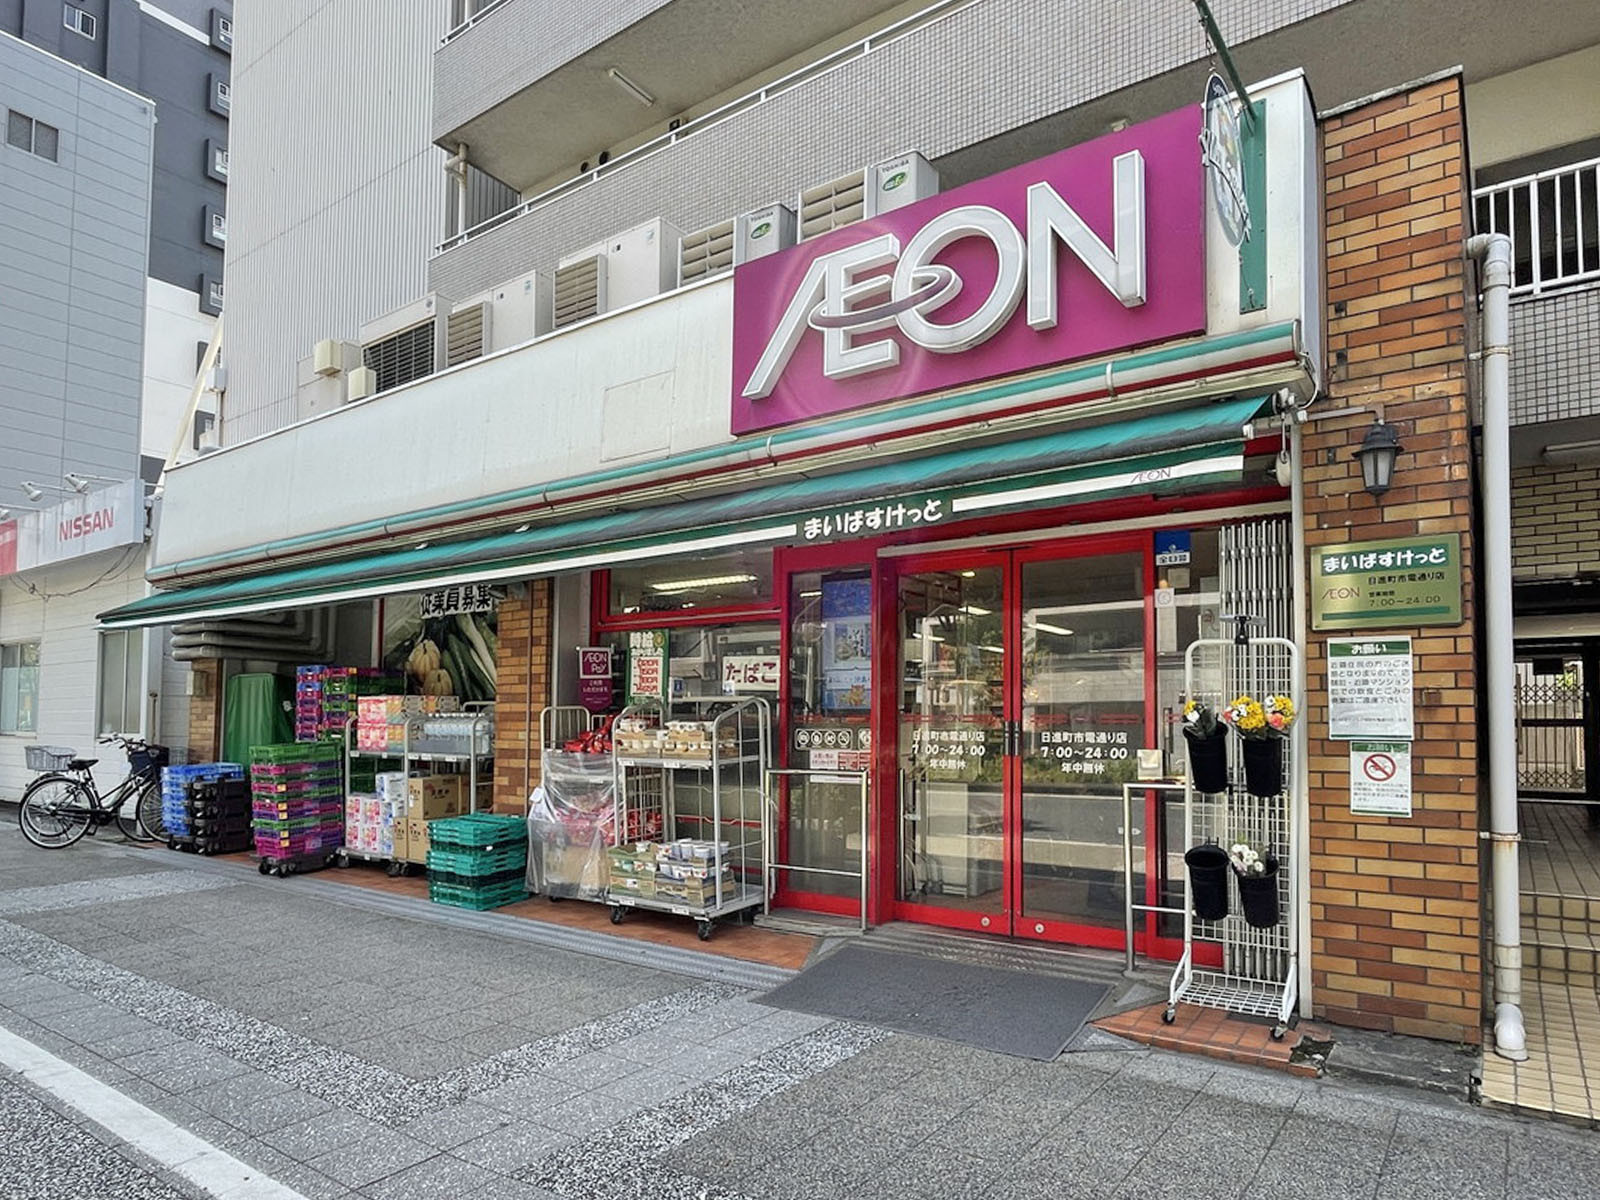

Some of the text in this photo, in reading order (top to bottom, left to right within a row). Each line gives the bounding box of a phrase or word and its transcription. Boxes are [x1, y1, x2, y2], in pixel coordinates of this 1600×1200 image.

[59, 506, 114, 542] NISSAN
[803, 499, 943, 540] まいばすけっと
[1323, 548, 1447, 572] まいばすけっと
[726, 662, 777, 683] たばこ
[912, 730, 985, 742] 日進町市電通り店
[1040, 731, 1128, 745] 日進町市電通り店
[930, 758, 967, 770] 年中無休
[1061, 762, 1105, 775] 年中無休
